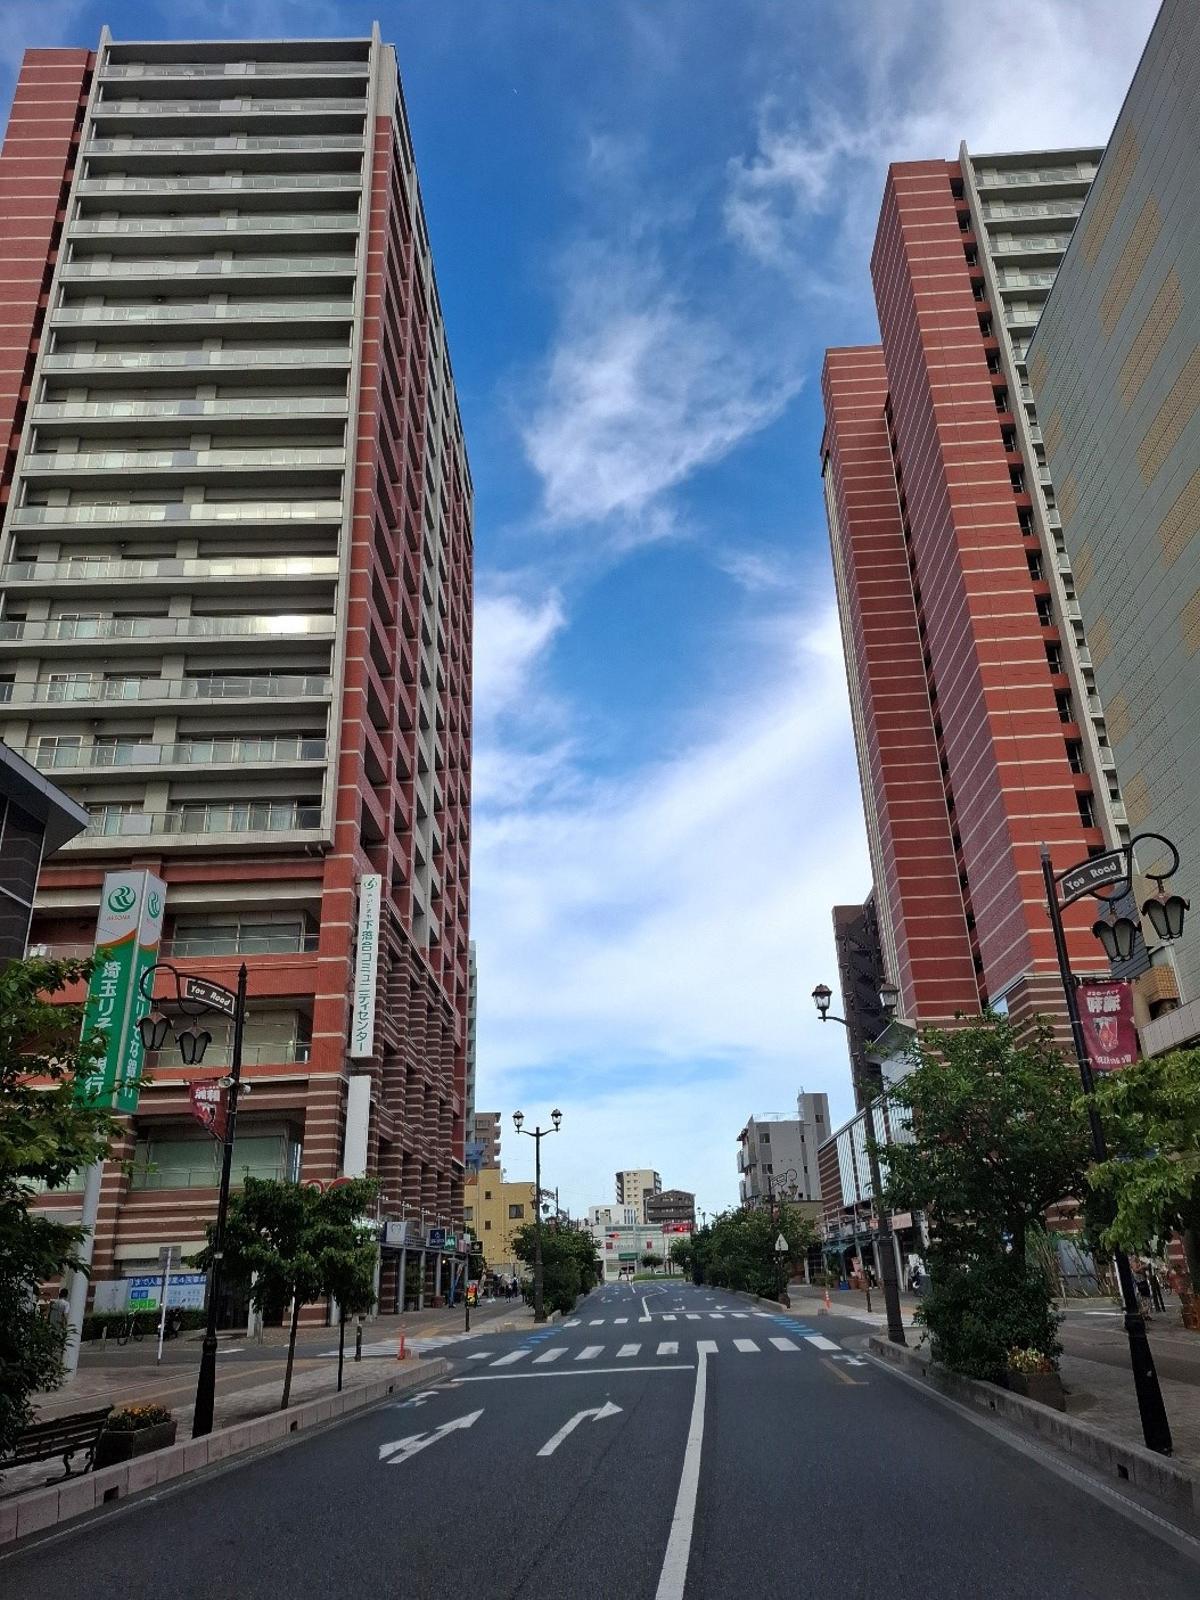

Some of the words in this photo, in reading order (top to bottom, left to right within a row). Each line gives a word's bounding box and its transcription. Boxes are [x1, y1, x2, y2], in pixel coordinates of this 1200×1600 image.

[1065, 877, 1085, 890] You
[1090, 862, 1117, 878] Road
[191, 985, 206, 995] You
[210, 991, 231, 1006] Road
